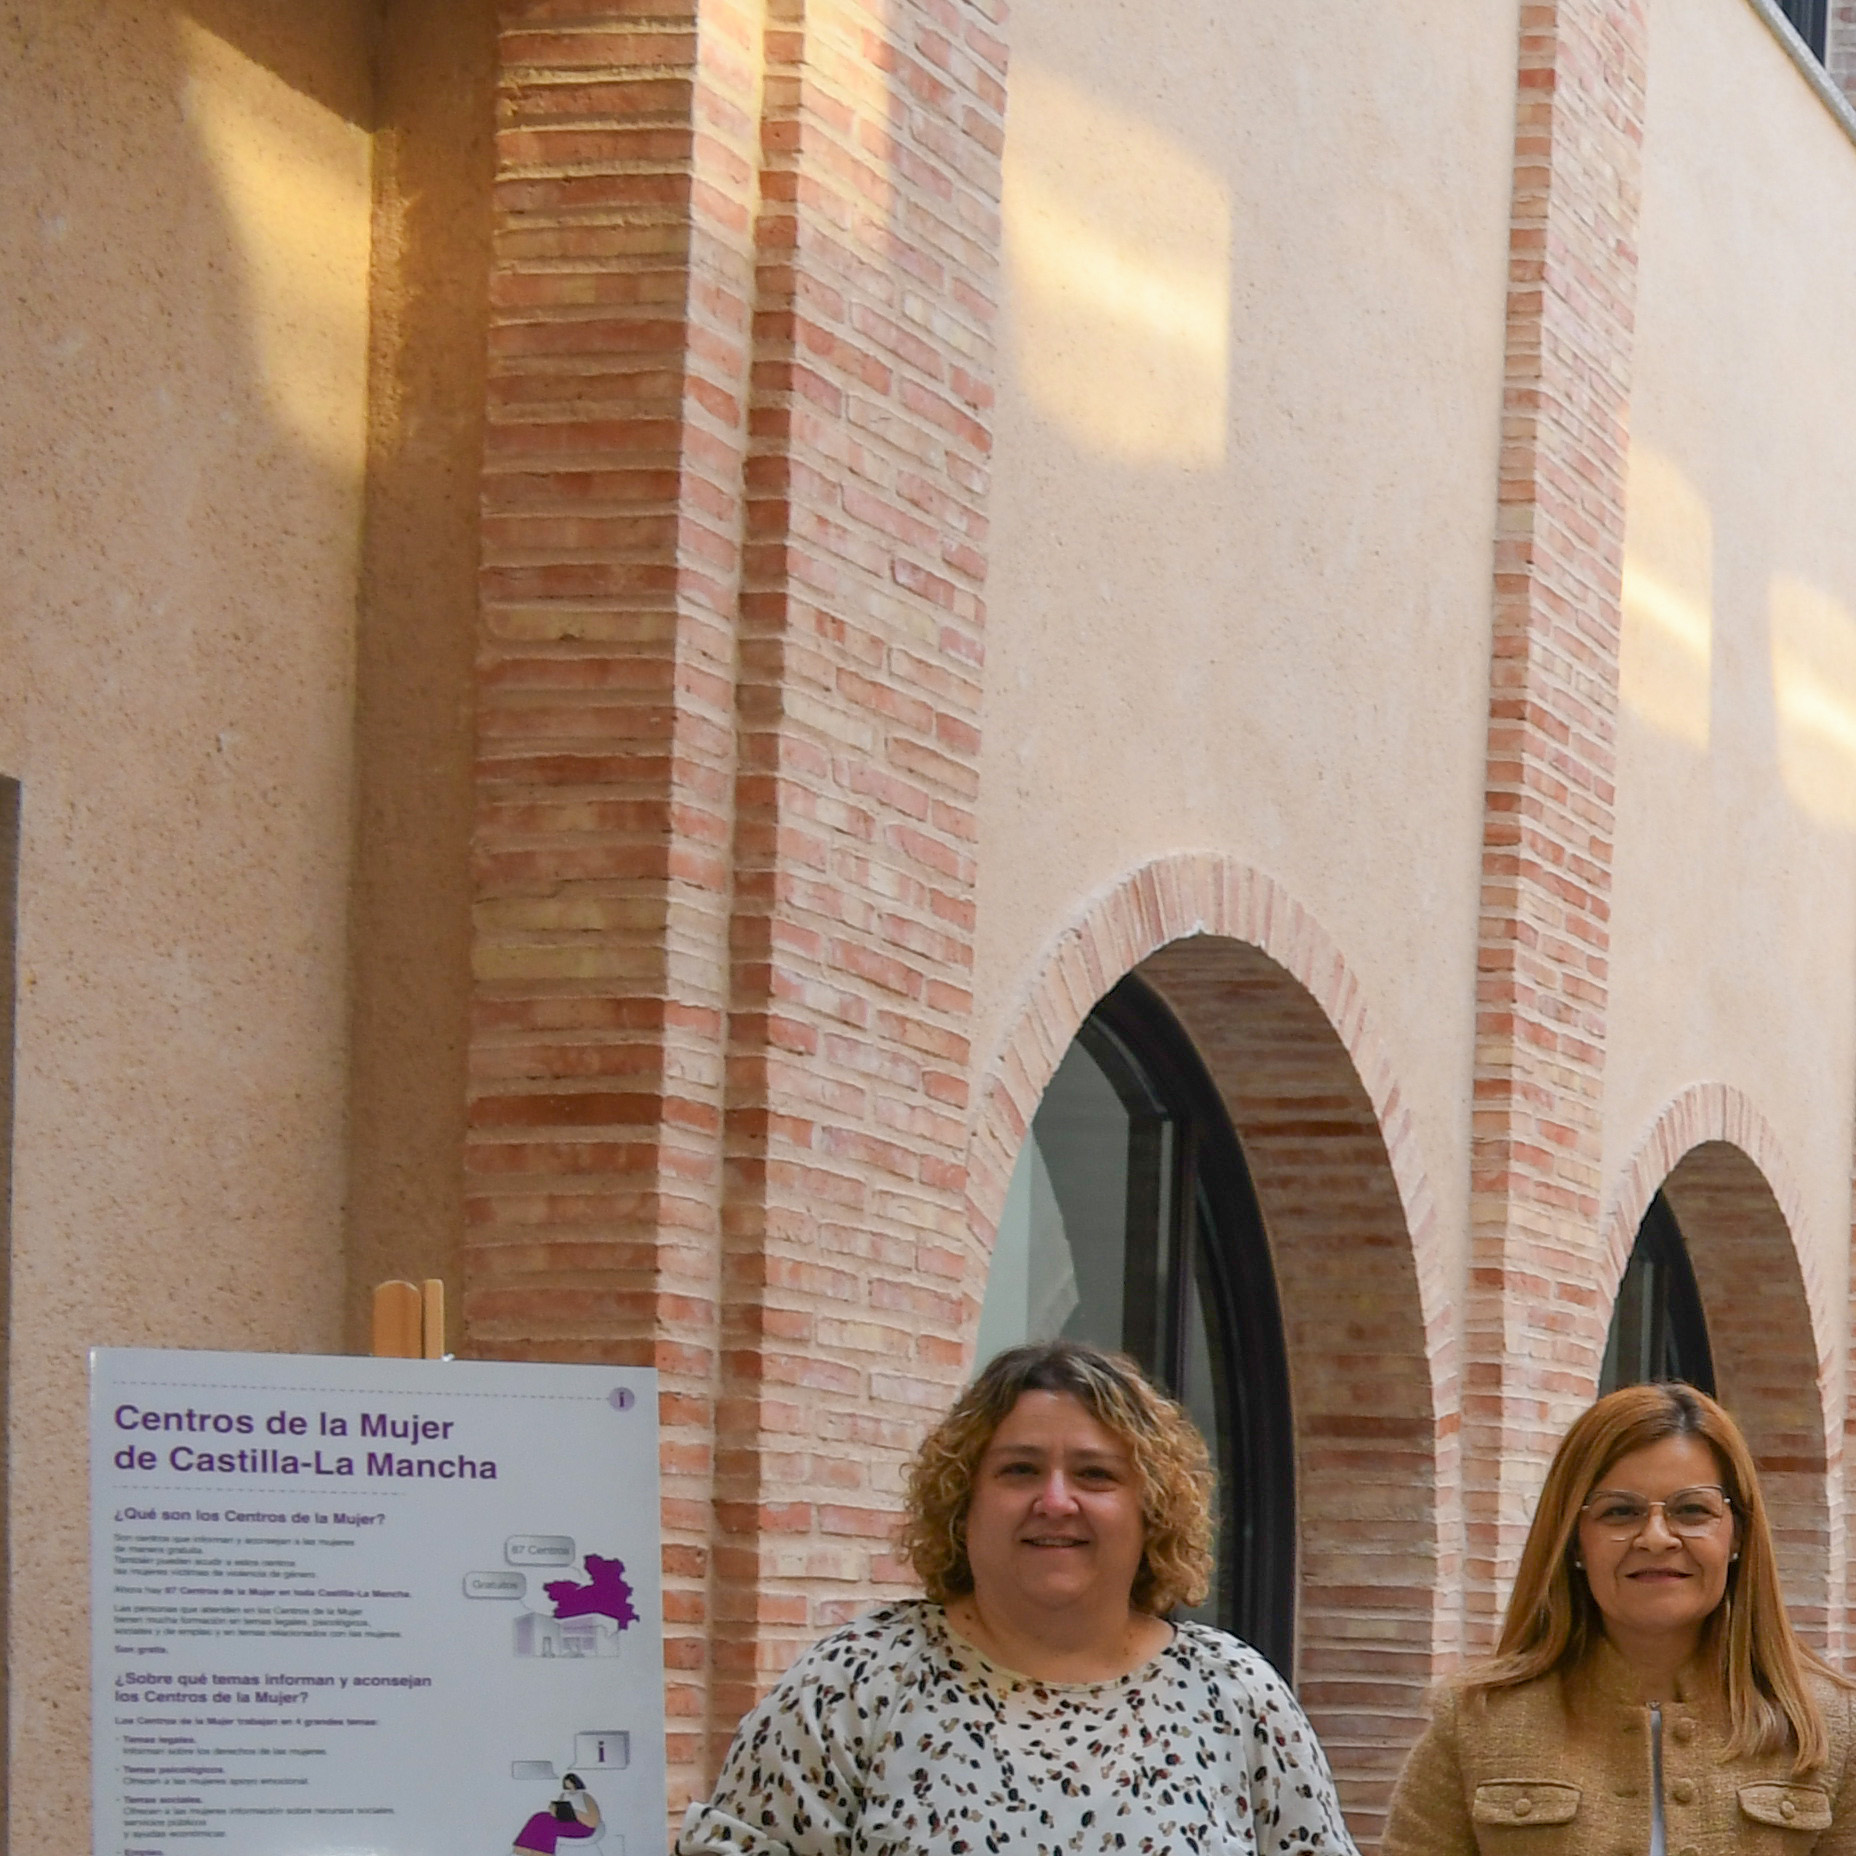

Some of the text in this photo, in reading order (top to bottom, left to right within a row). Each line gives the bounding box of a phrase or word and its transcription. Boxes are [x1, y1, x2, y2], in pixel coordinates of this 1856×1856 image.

[114, 1404, 455, 1446] Centros de la Mujer
[113, 1444, 497, 1480] de Castilla-La Mancha
[113, 1506, 386, 1528] ¿Qué son los Centros de la Mujer?
[114, 1671, 432, 1690] ¿Sobre qué temas informan y aconsejan
[114, 1690, 309, 1706] los Centros de la Mujer?
